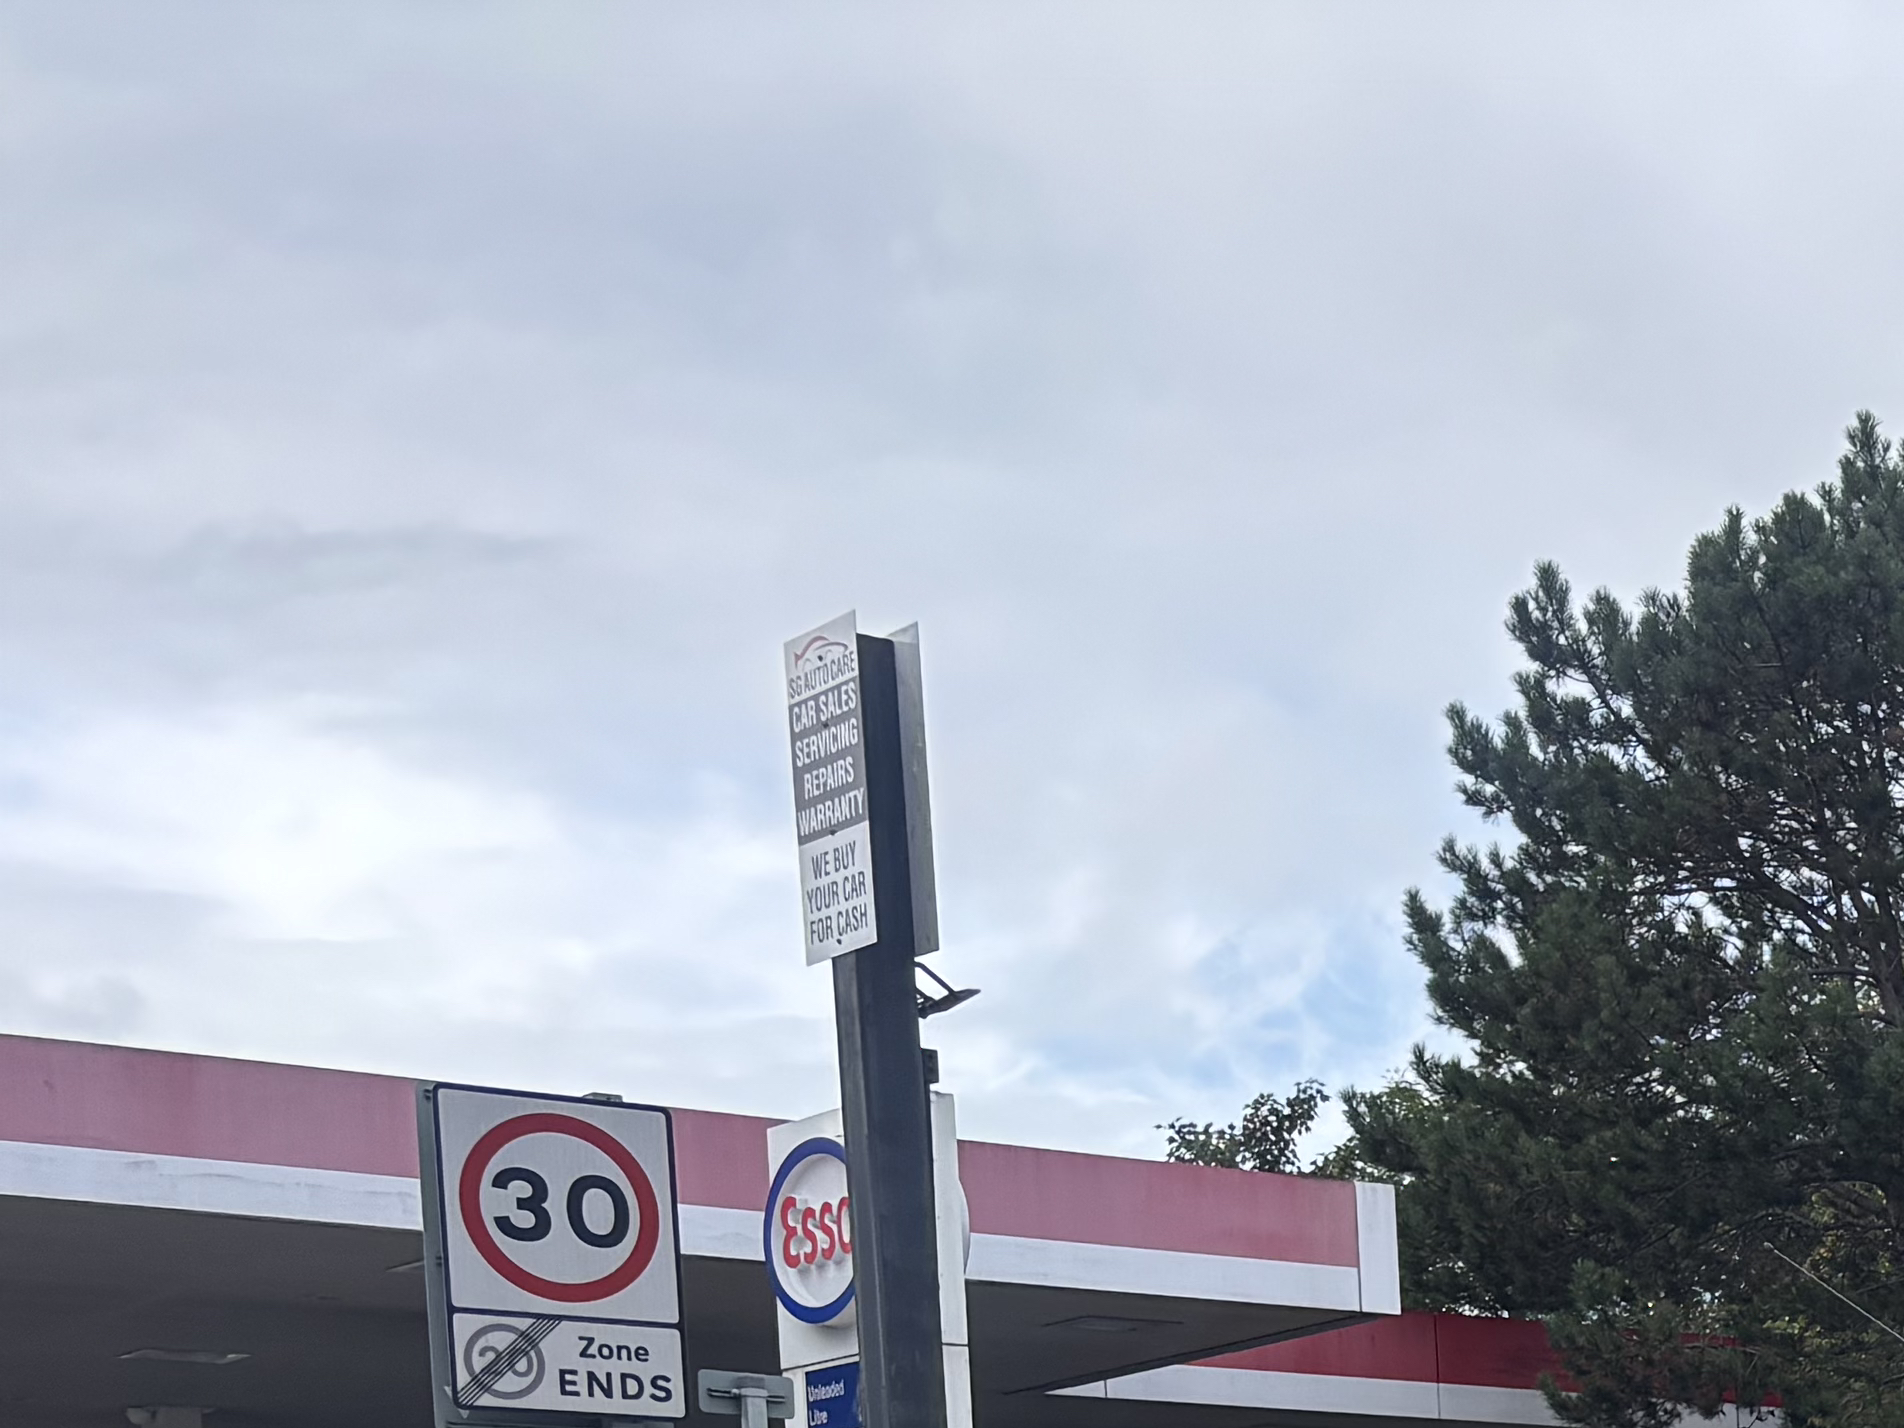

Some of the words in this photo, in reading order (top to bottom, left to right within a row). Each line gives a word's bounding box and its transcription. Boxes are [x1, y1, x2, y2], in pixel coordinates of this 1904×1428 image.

[789, 677, 803, 699] SG
[803, 663, 829, 694] AUTO
[829, 651, 855, 681] CARE
[793, 700, 816, 733] CAR
[819, 681, 856, 722] SALES
[795, 718, 859, 767] SERVICING
[804, 756, 854, 800] REPAIRS
[798, 787, 865, 836] WARRANTY
[811, 851, 831, 881] WE
[834, 840, 856, 873] BUY
[807, 881, 840, 914] YOUR
[843, 871, 867, 901] CAR
[810, 917, 834, 945] FOR
[837, 902, 868, 937] CASH
[492, 1166, 630, 1248] 30
[578, 1336, 650, 1362] Zone
[559, 1368, 673, 1402] ENDS
[807, 1379, 845, 1402] Unleaded
